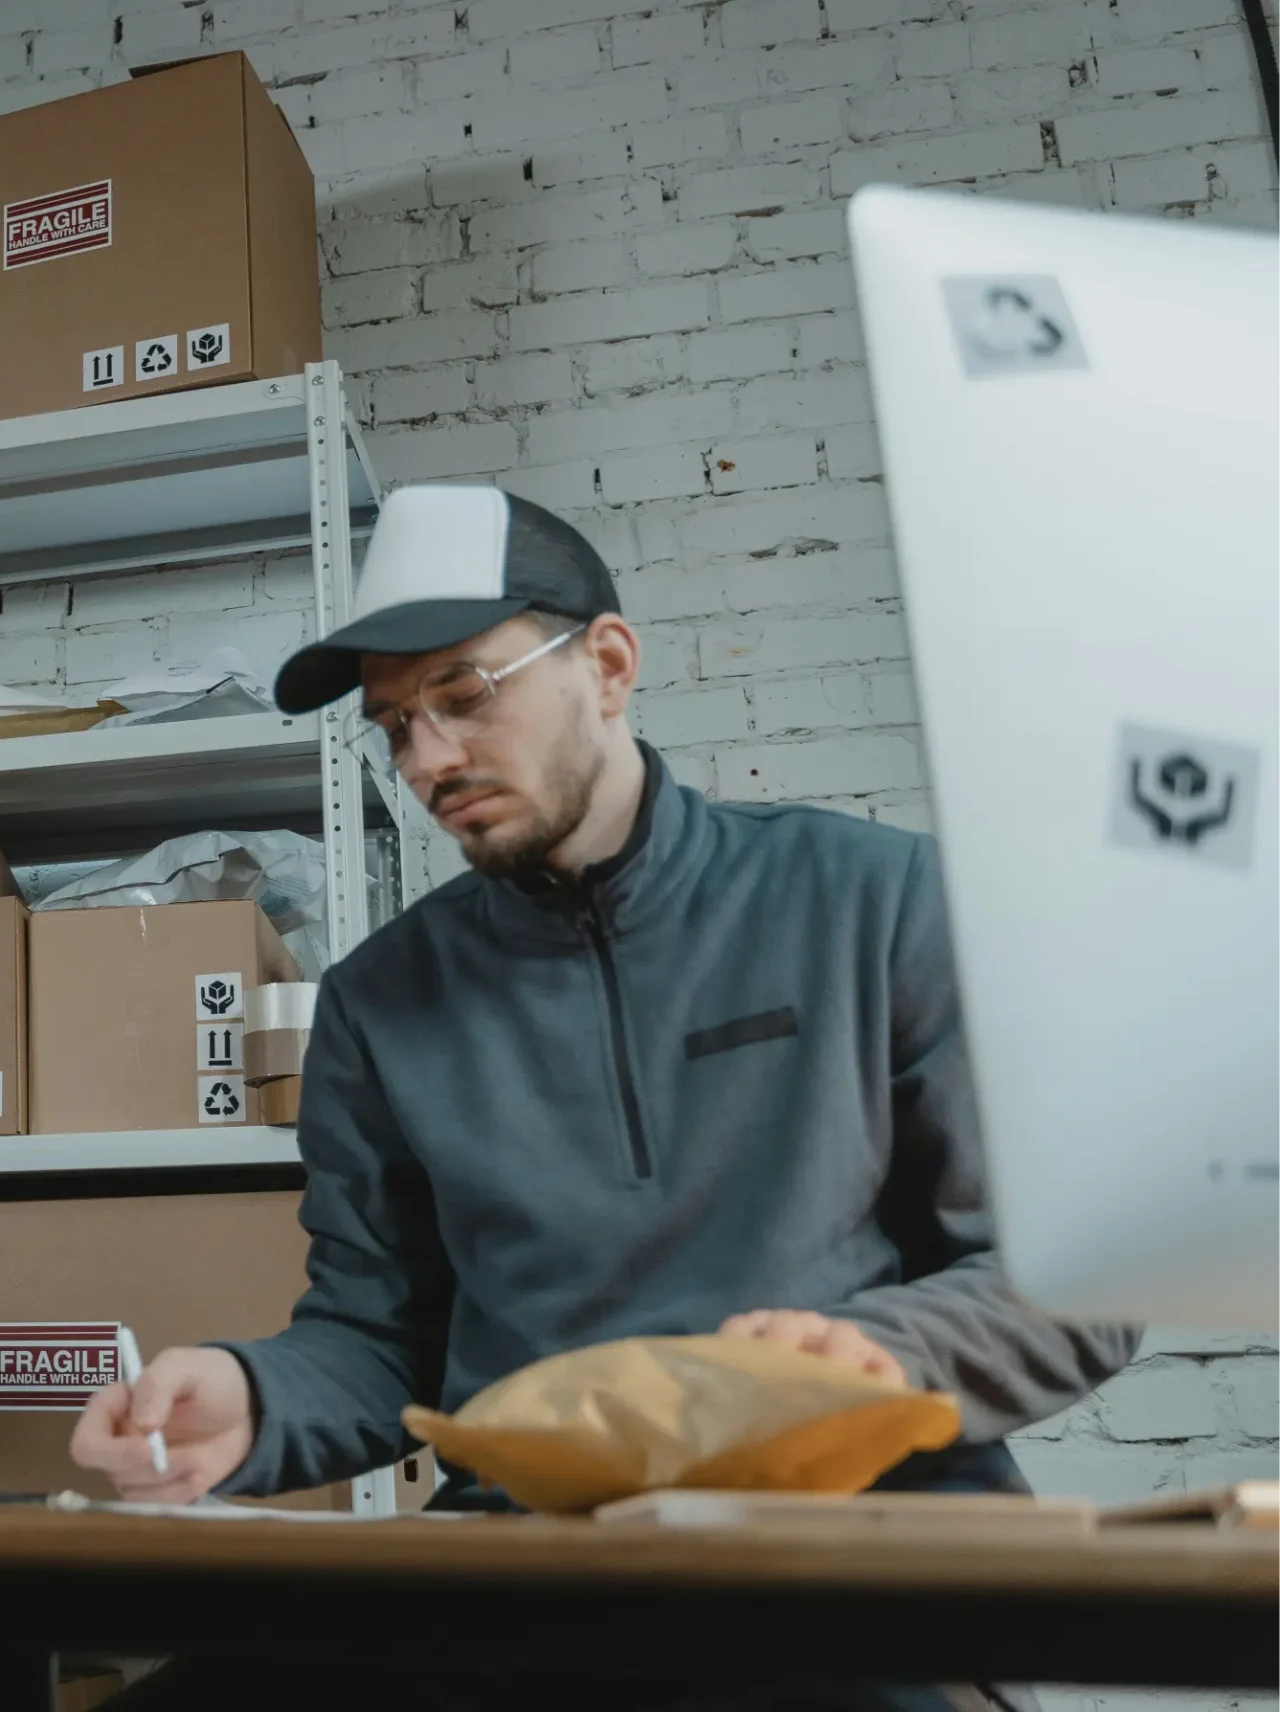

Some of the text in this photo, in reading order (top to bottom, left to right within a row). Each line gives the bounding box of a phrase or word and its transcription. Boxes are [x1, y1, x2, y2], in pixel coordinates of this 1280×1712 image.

[8, 201, 106, 241] FRAGILE
[8, 219, 106, 250] HANDLE WITH CARE
[0, 1350, 115, 1373] FRAGILE
[0, 1373, 115, 1384] HANDLE WITH CARE
